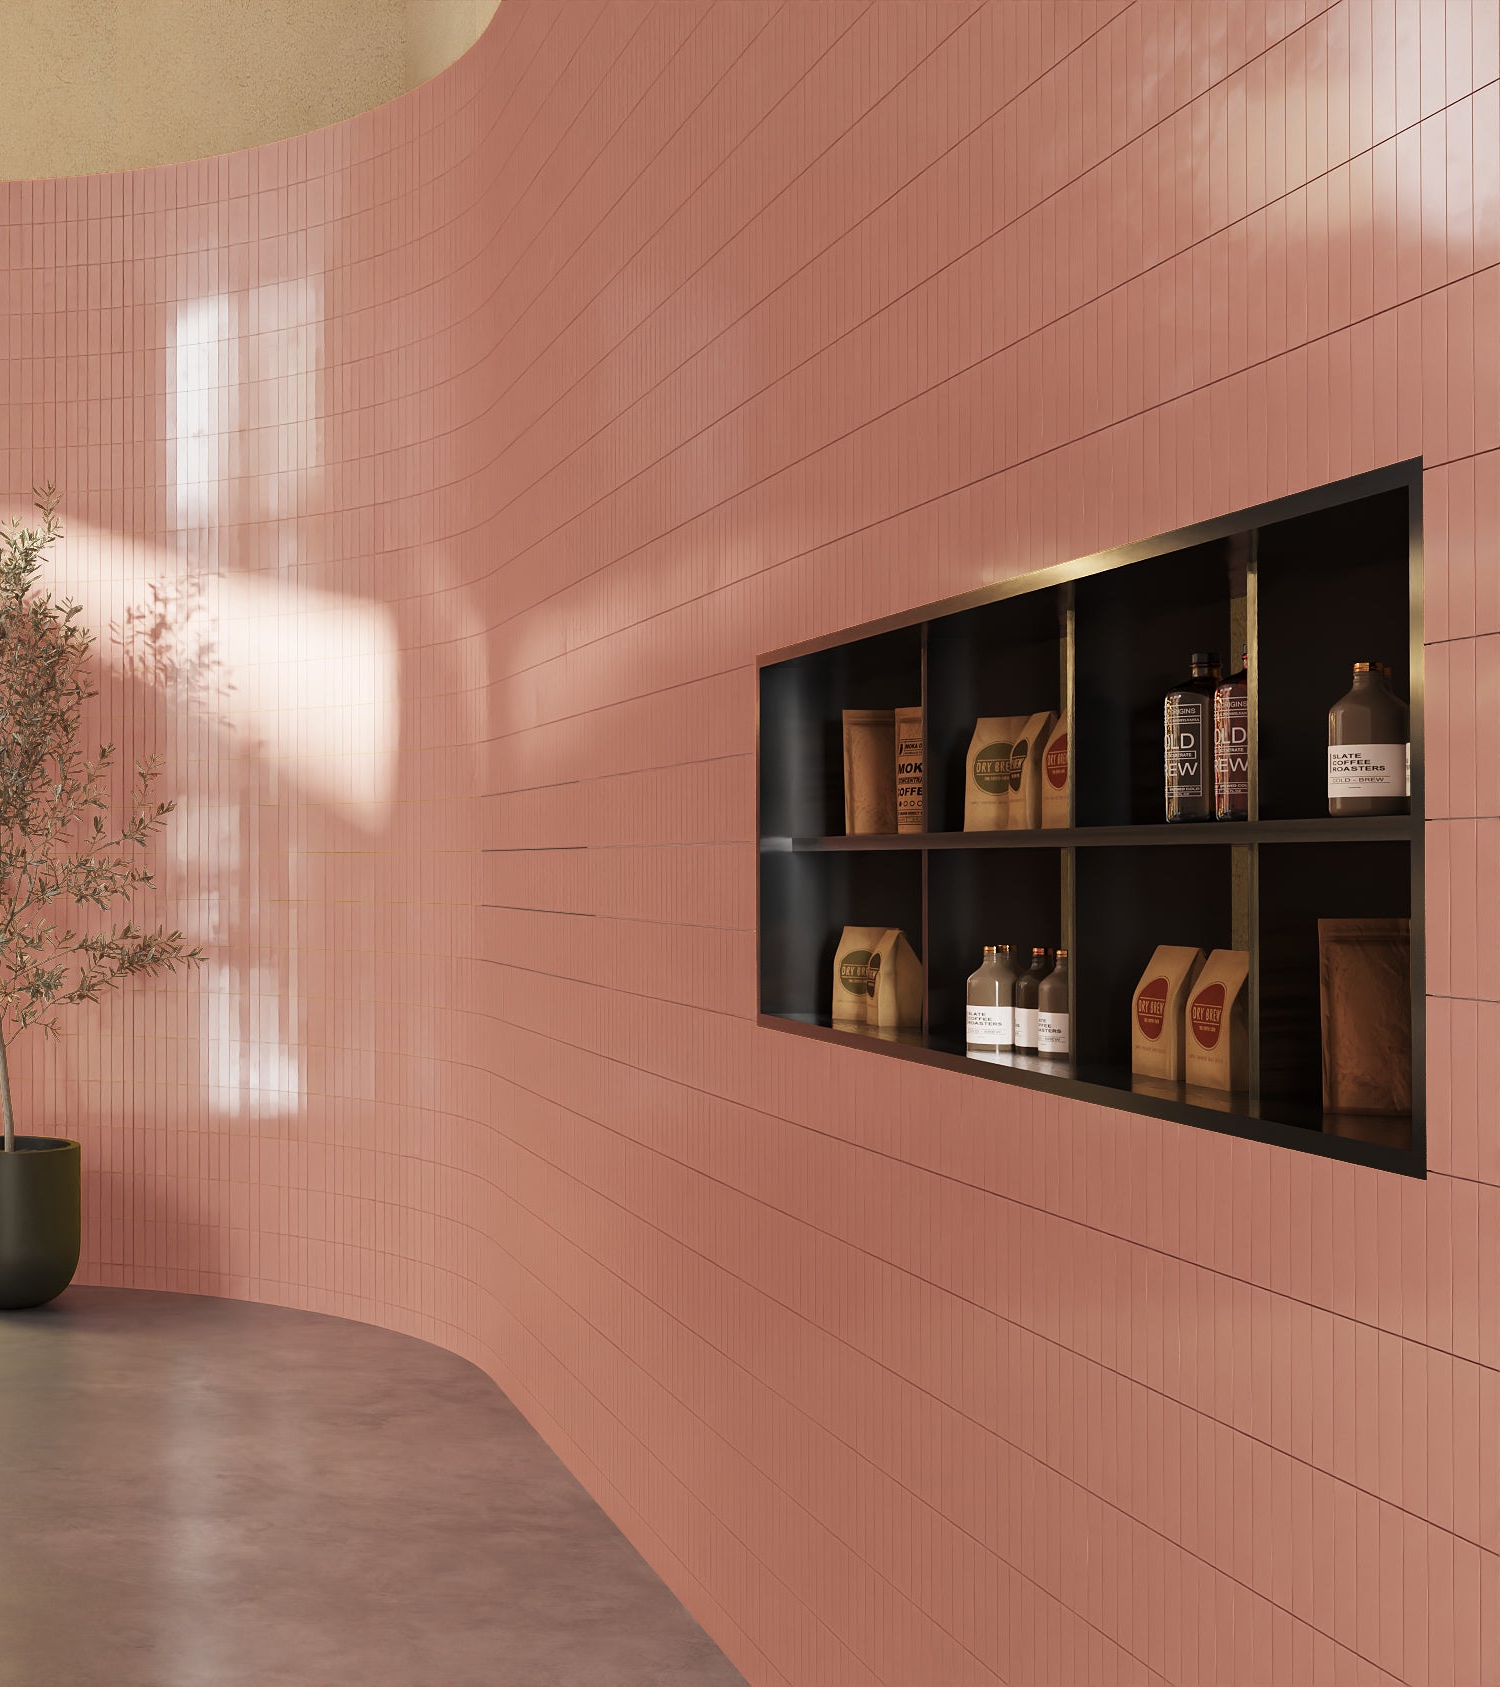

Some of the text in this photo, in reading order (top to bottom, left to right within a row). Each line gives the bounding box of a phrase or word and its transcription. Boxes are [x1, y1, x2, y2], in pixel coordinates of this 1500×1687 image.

[1164, 733, 1195, 750] OLD
[1214, 727, 1247, 745] OLD
[898, 762, 923, 774] MOK
[976, 761, 992, 773] DRY
[994, 760, 1010, 772] BRE
[1164, 762, 1198, 776] REW
[1214, 757, 1248, 772] REW
[898, 787, 923, 796] OFFE
[1138, 999, 1150, 1013] DRY
[1192, 1006, 1205, 1020] DRY
